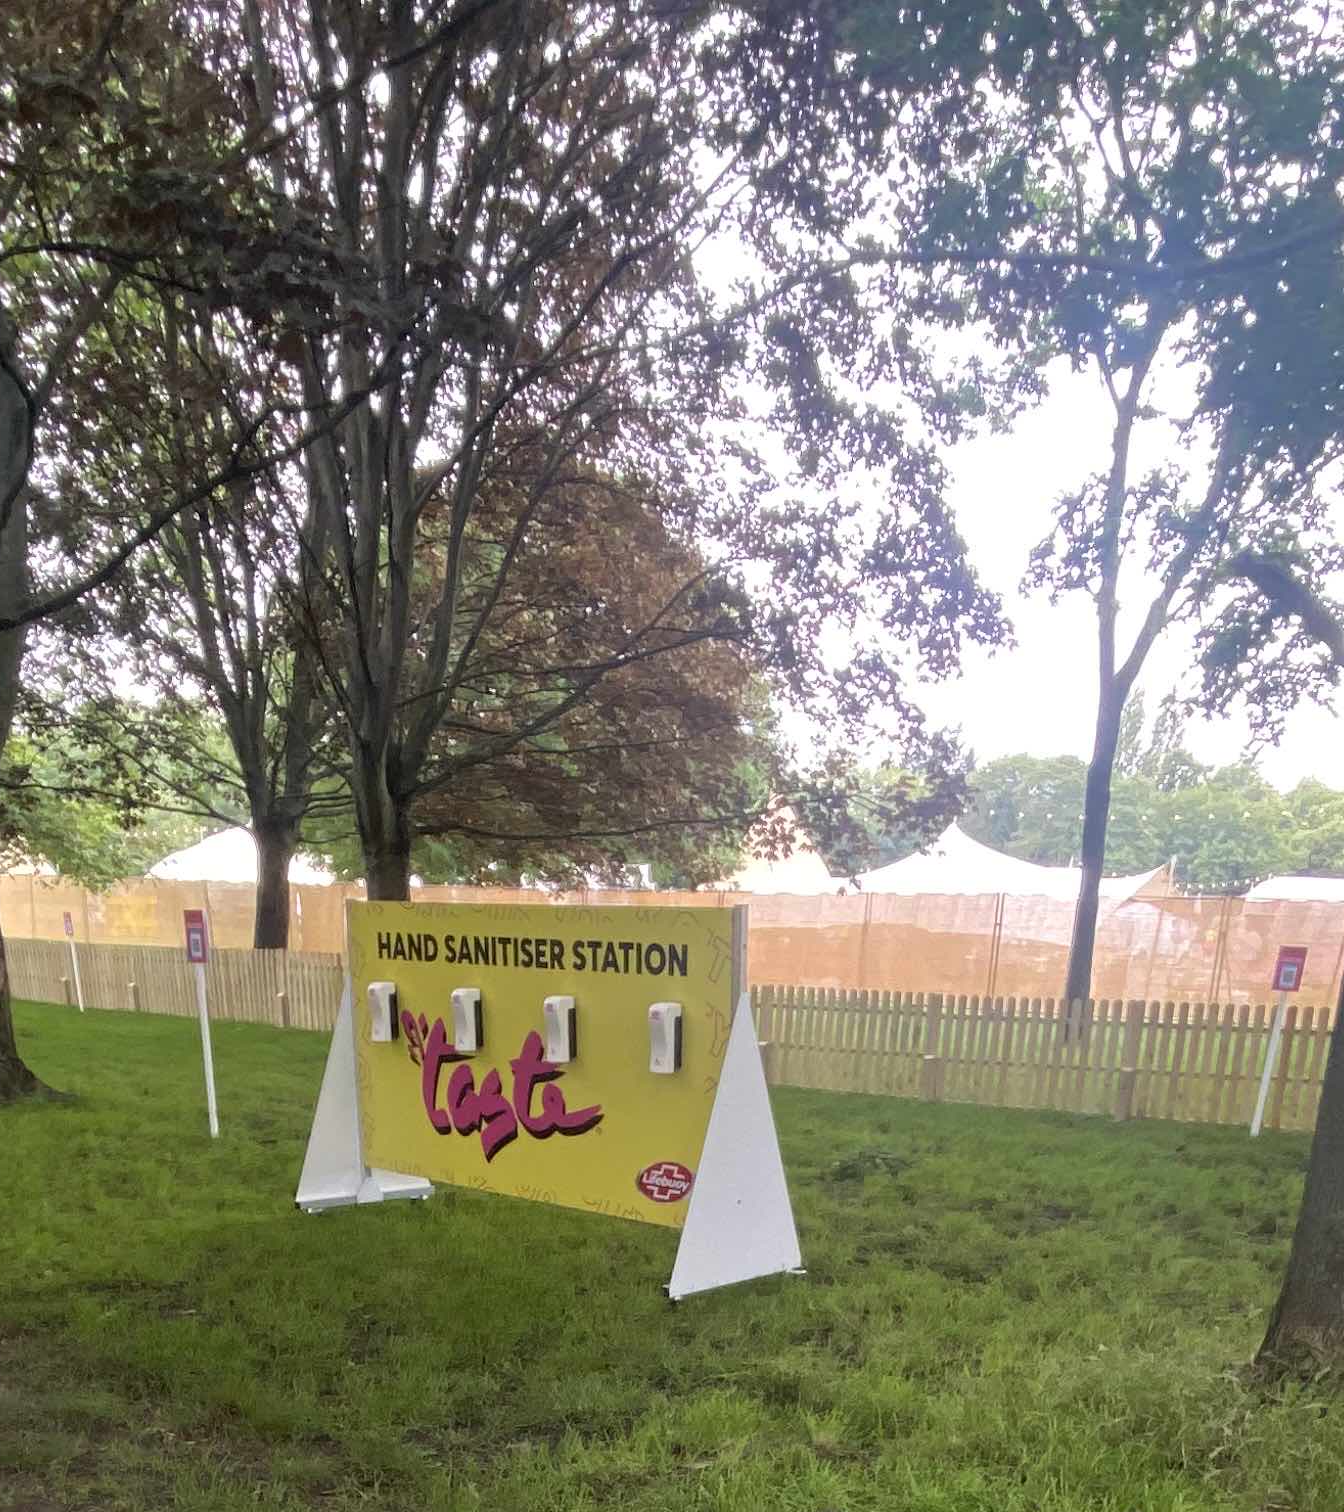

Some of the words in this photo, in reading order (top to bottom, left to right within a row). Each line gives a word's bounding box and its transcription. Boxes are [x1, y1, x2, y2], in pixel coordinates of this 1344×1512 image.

[377, 932, 438, 962] HAND
[445, 934, 565, 970] SANITISER
[572, 940, 688, 977] STATION
